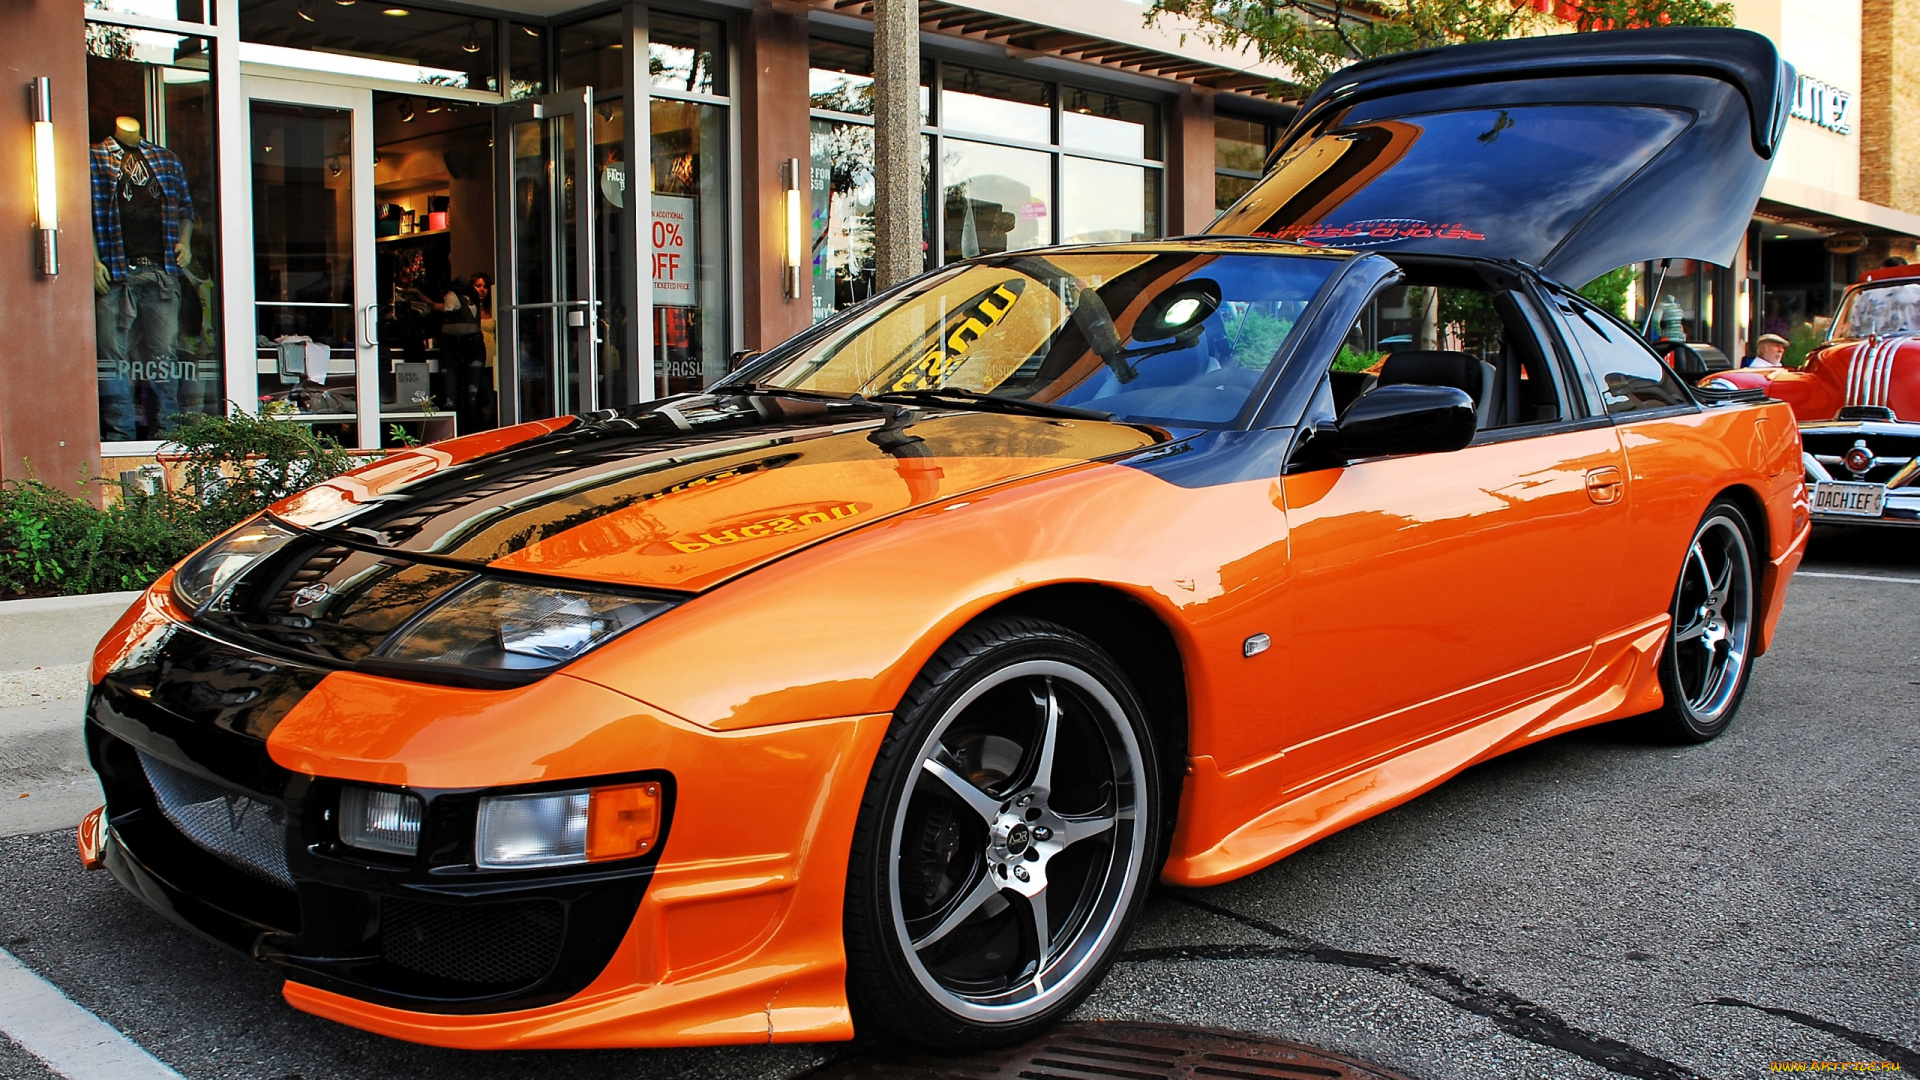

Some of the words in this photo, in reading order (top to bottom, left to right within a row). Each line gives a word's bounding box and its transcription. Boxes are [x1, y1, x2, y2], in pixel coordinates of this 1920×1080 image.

[815, 168, 830, 180] FOR
[656, 210, 685, 220] ADDITIONAL
[677, 283, 691, 291] PRICE
[1817, 490, 1874, 509] DACHIEF
[1009, 830, 1028, 845] ADR
